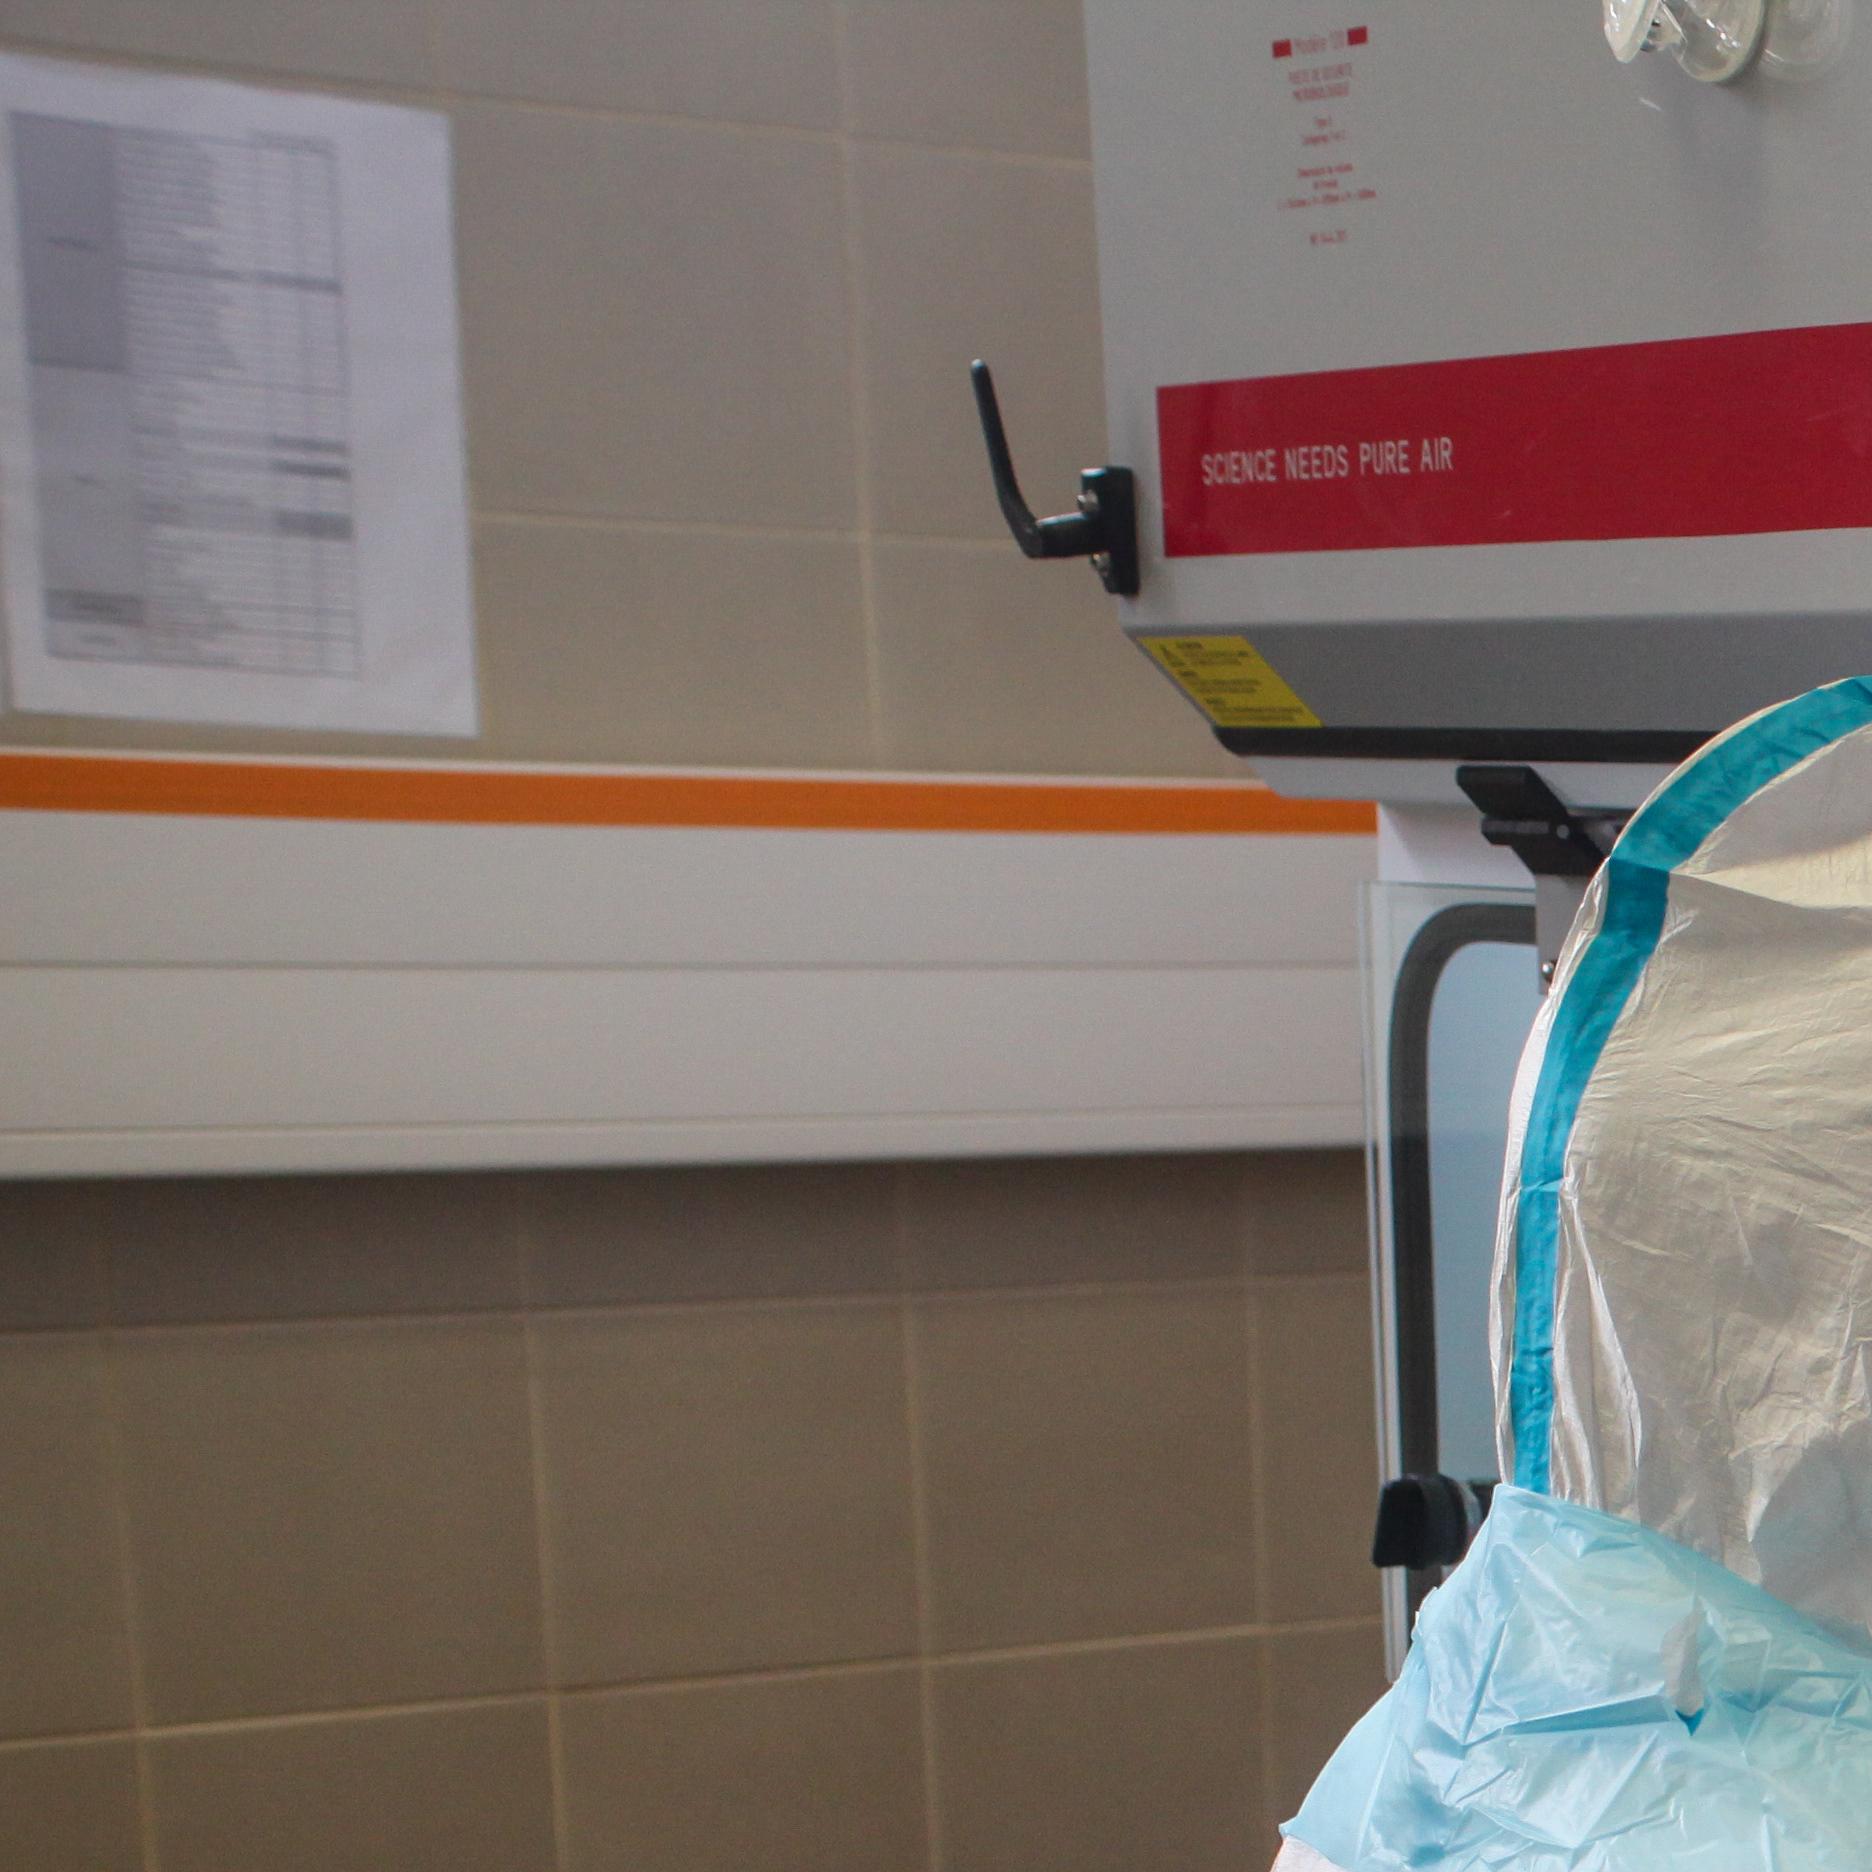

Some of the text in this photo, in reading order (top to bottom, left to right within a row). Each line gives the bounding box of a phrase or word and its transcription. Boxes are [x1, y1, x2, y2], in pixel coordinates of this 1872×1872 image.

[1202, 437, 1454, 486] SCIENCE NEEDS PURE AIR
